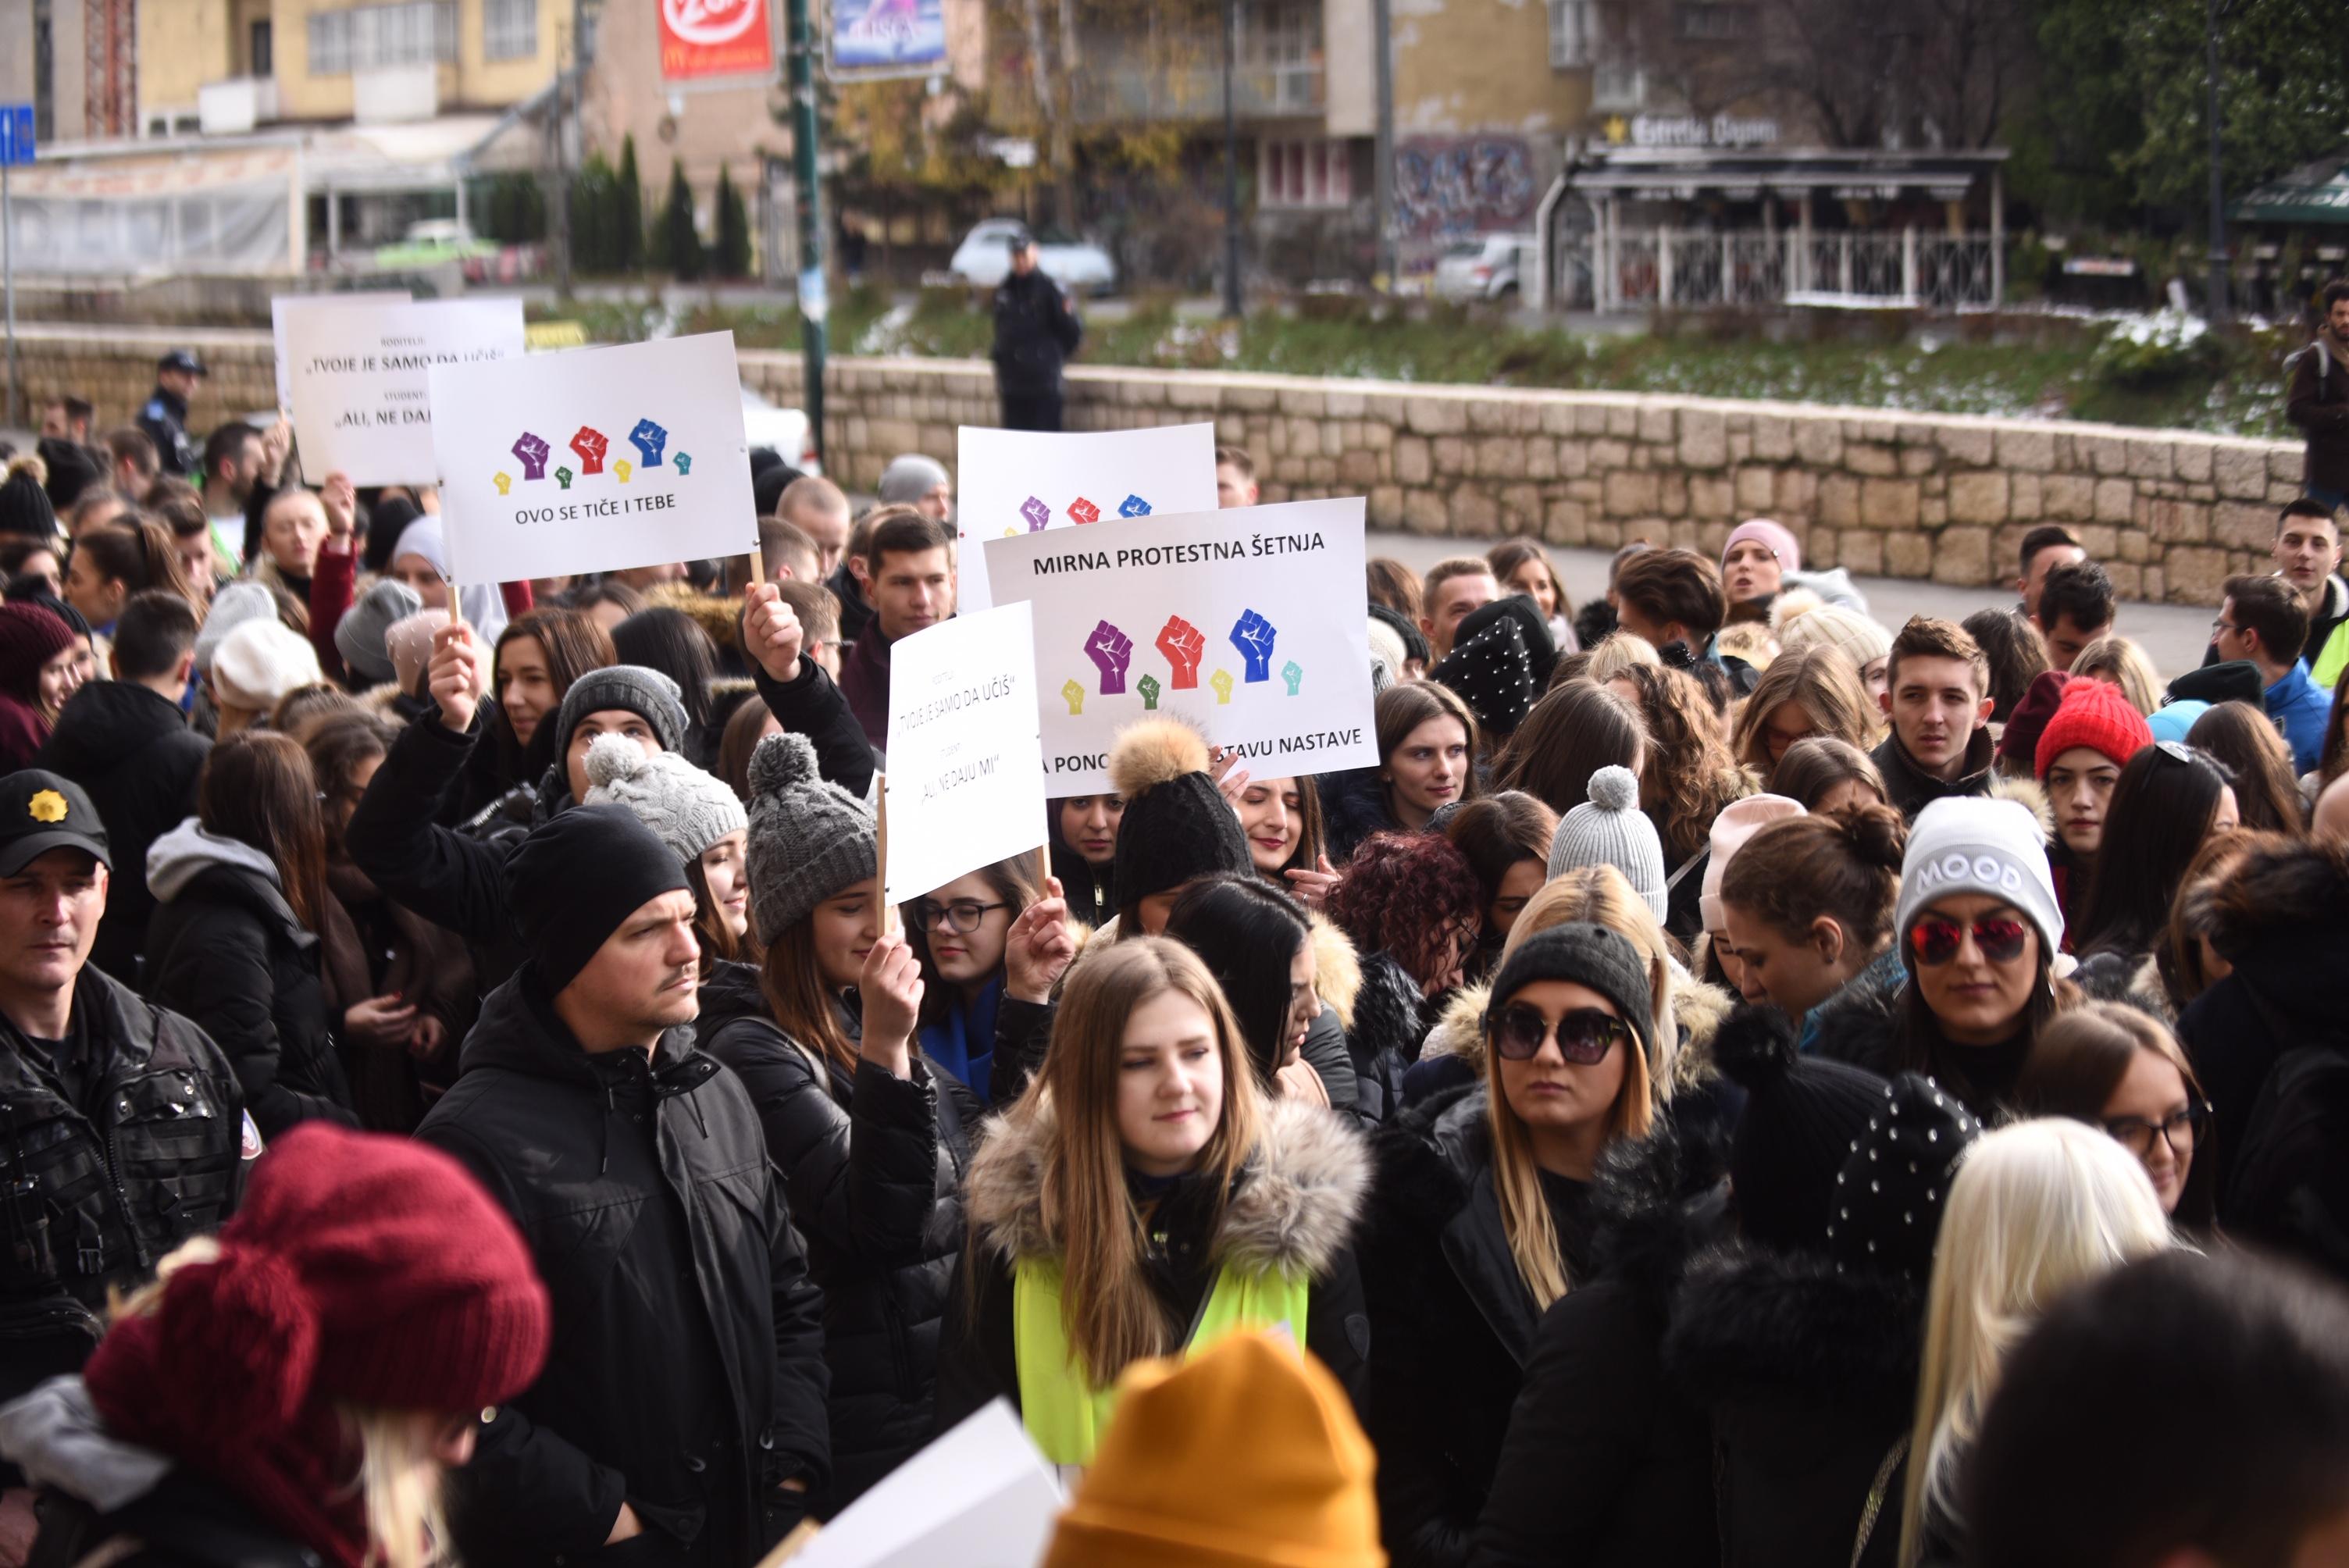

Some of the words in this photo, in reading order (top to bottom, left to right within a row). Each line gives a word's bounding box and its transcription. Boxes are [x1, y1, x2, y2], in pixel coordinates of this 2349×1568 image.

[362, 355, 376, 372] JE
[381, 354, 431, 371] SAMO
[376, 410, 398, 426] NE
[515, 508, 554, 524] OVO
[560, 506, 578, 520] SE
[583, 498, 619, 518] TIČE
[625, 500, 629, 513] I
[634, 494, 675, 511] TEBE
[1033, 551, 1110, 576] MIRNA
[1117, 540, 1246, 568] PROTESTNA
[1252, 532, 1324, 557] ŠETNJA
[925, 704, 933, 723] JE
[936, 693, 961, 718] SAMO
[964, 688, 980, 707] DA
[1279, 728, 1363, 754] NASTAVE
[939, 773, 950, 792] NE
[952, 763, 975, 787] DAJU
[1916, 853, 2023, 895] MOOD
